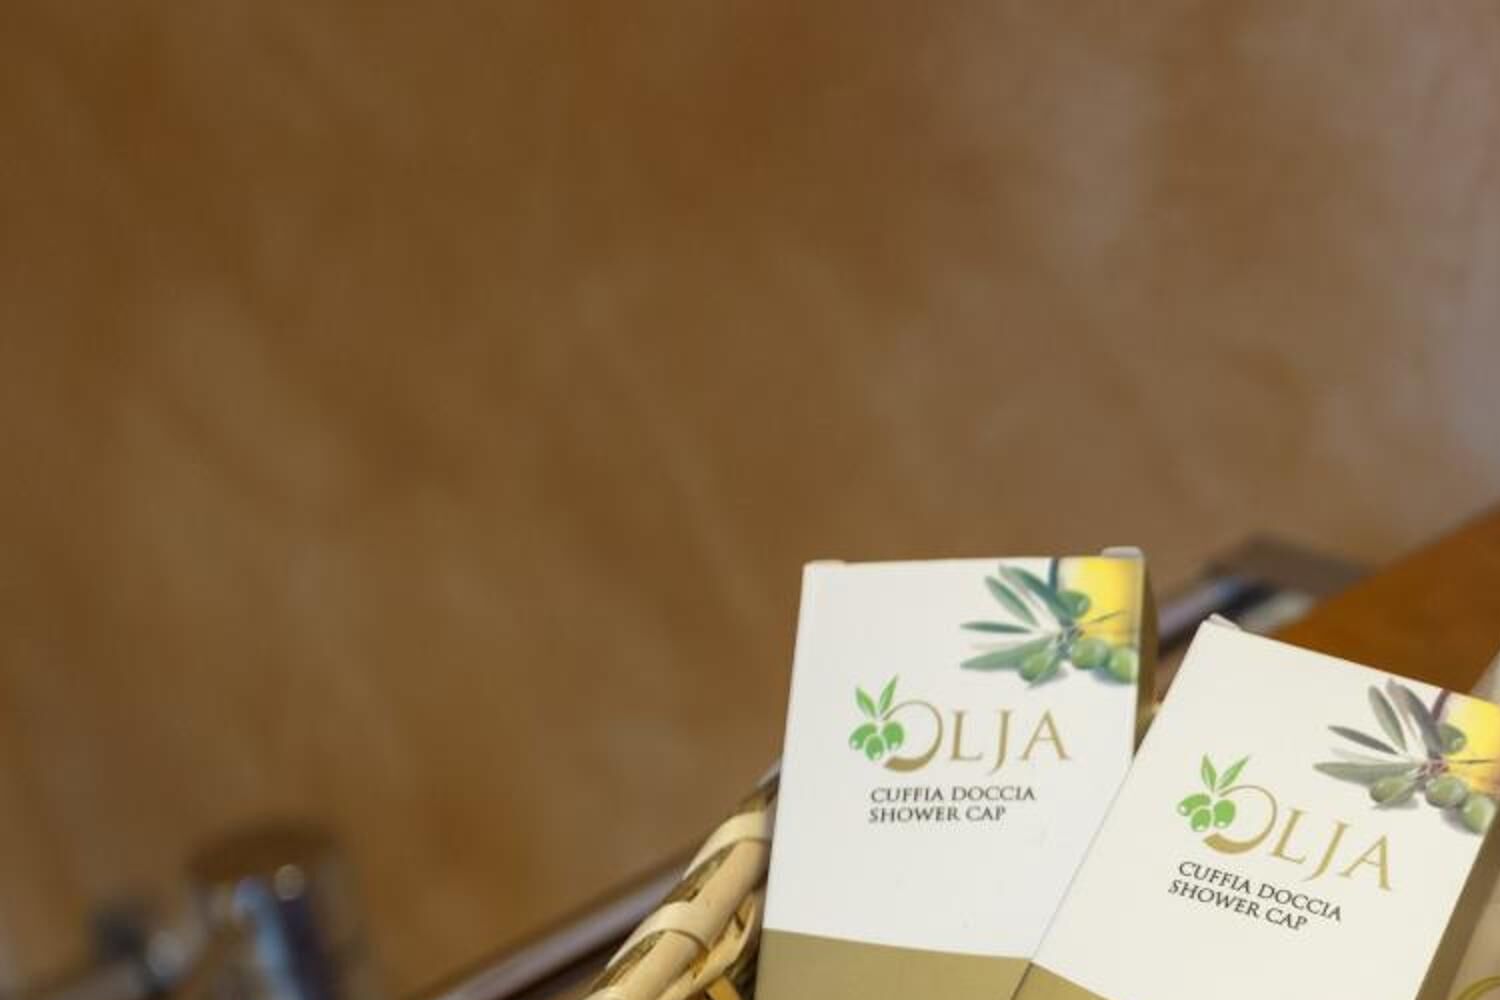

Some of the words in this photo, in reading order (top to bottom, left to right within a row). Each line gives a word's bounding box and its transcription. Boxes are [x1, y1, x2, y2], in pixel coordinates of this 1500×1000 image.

[878, 697, 1072, 777] OLJA
[868, 806, 960, 823] SHOWER
[965, 805, 1007, 822] CAP
[870, 786, 944, 803] CUFFIA
[951, 785, 1036, 801] DOCCIA
[1200, 783, 1392, 892] OLJA
[1168, 878, 1260, 918] SHOWER
[1265, 906, 1308, 931] CAP
[1178, 860, 1251, 894] CUFFIA
[1257, 882, 1342, 922] DOCCIA
